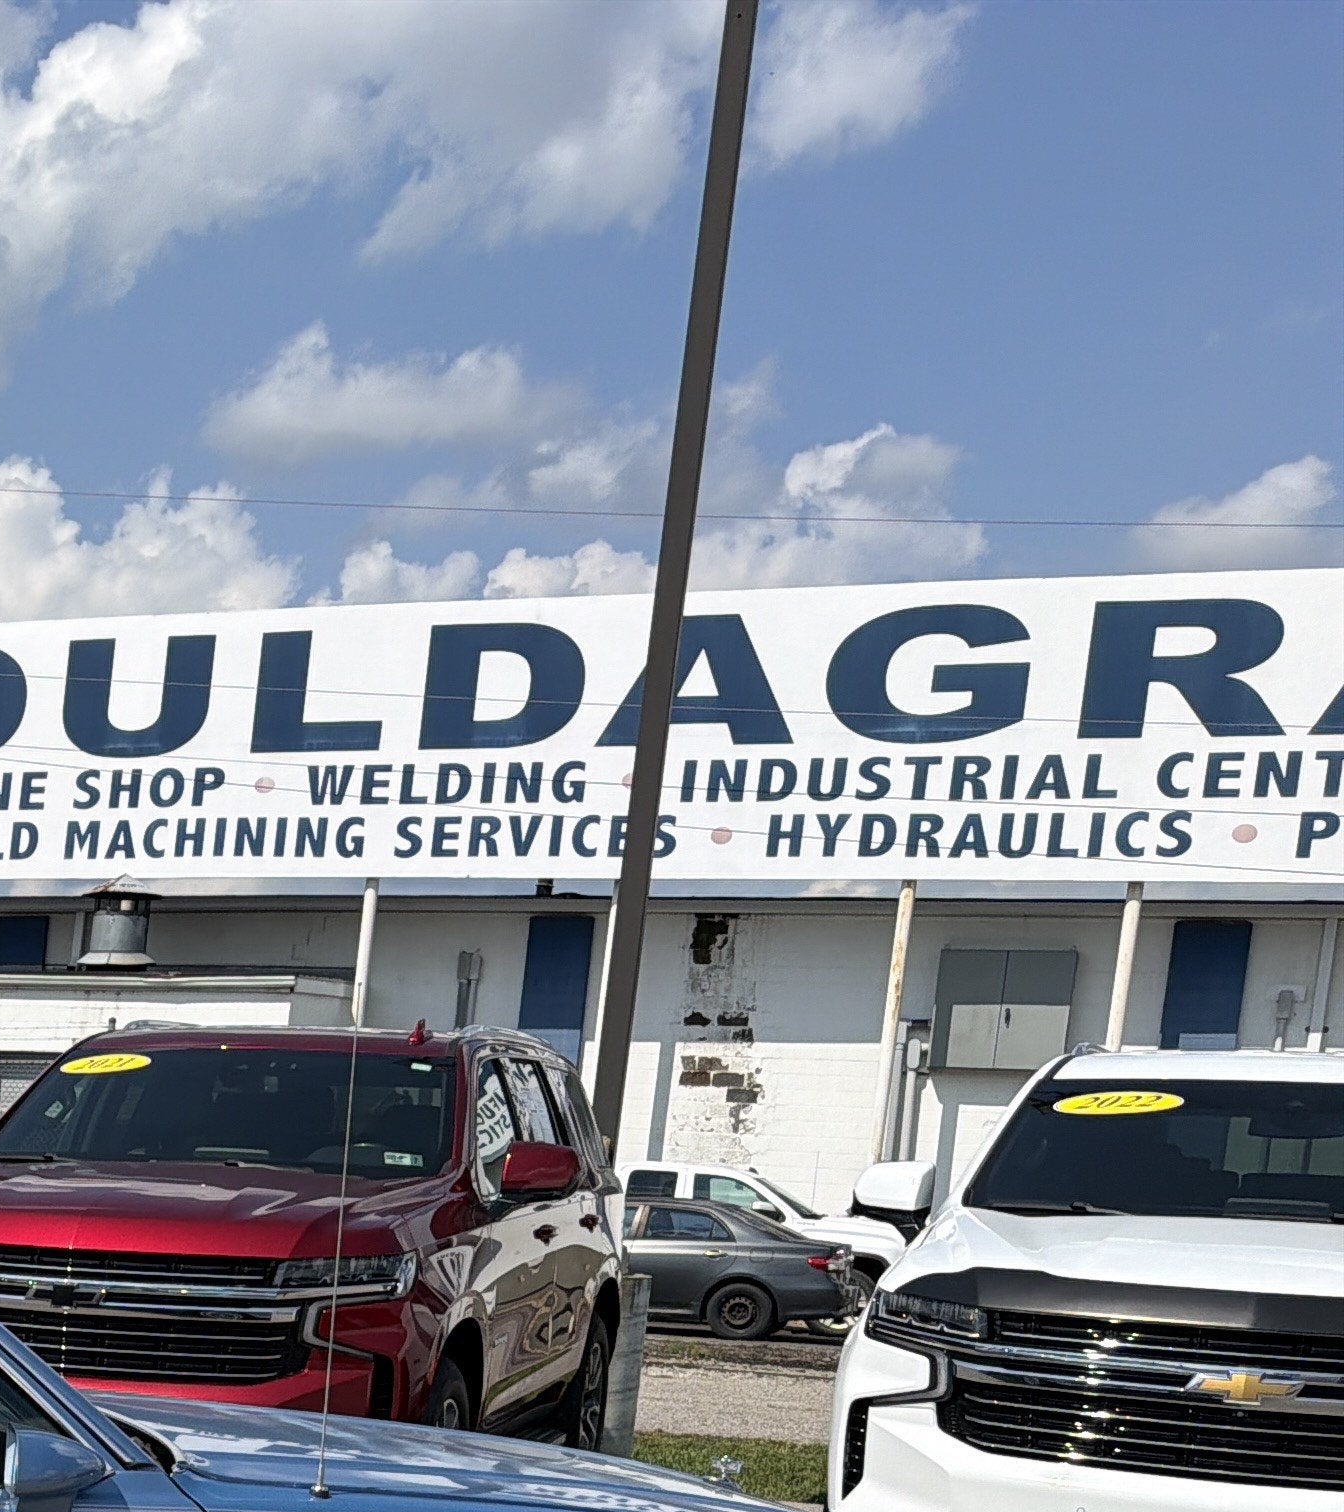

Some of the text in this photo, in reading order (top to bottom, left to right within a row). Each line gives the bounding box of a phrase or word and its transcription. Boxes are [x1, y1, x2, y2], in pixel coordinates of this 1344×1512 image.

[73, 767, 226, 810] SHOP
[307, 761, 586, 806] WELDING
[680, 754, 1118, 803] INDUSTRIAL
[1156, 750, 1344, 799] CENT
[64, 816, 365, 860] MACHINING
[394, 814, 677, 859] SERVICES
[766, 809, 1193, 859] HYDRAULICS
[1073, 1095, 1163, 1110] 2022
